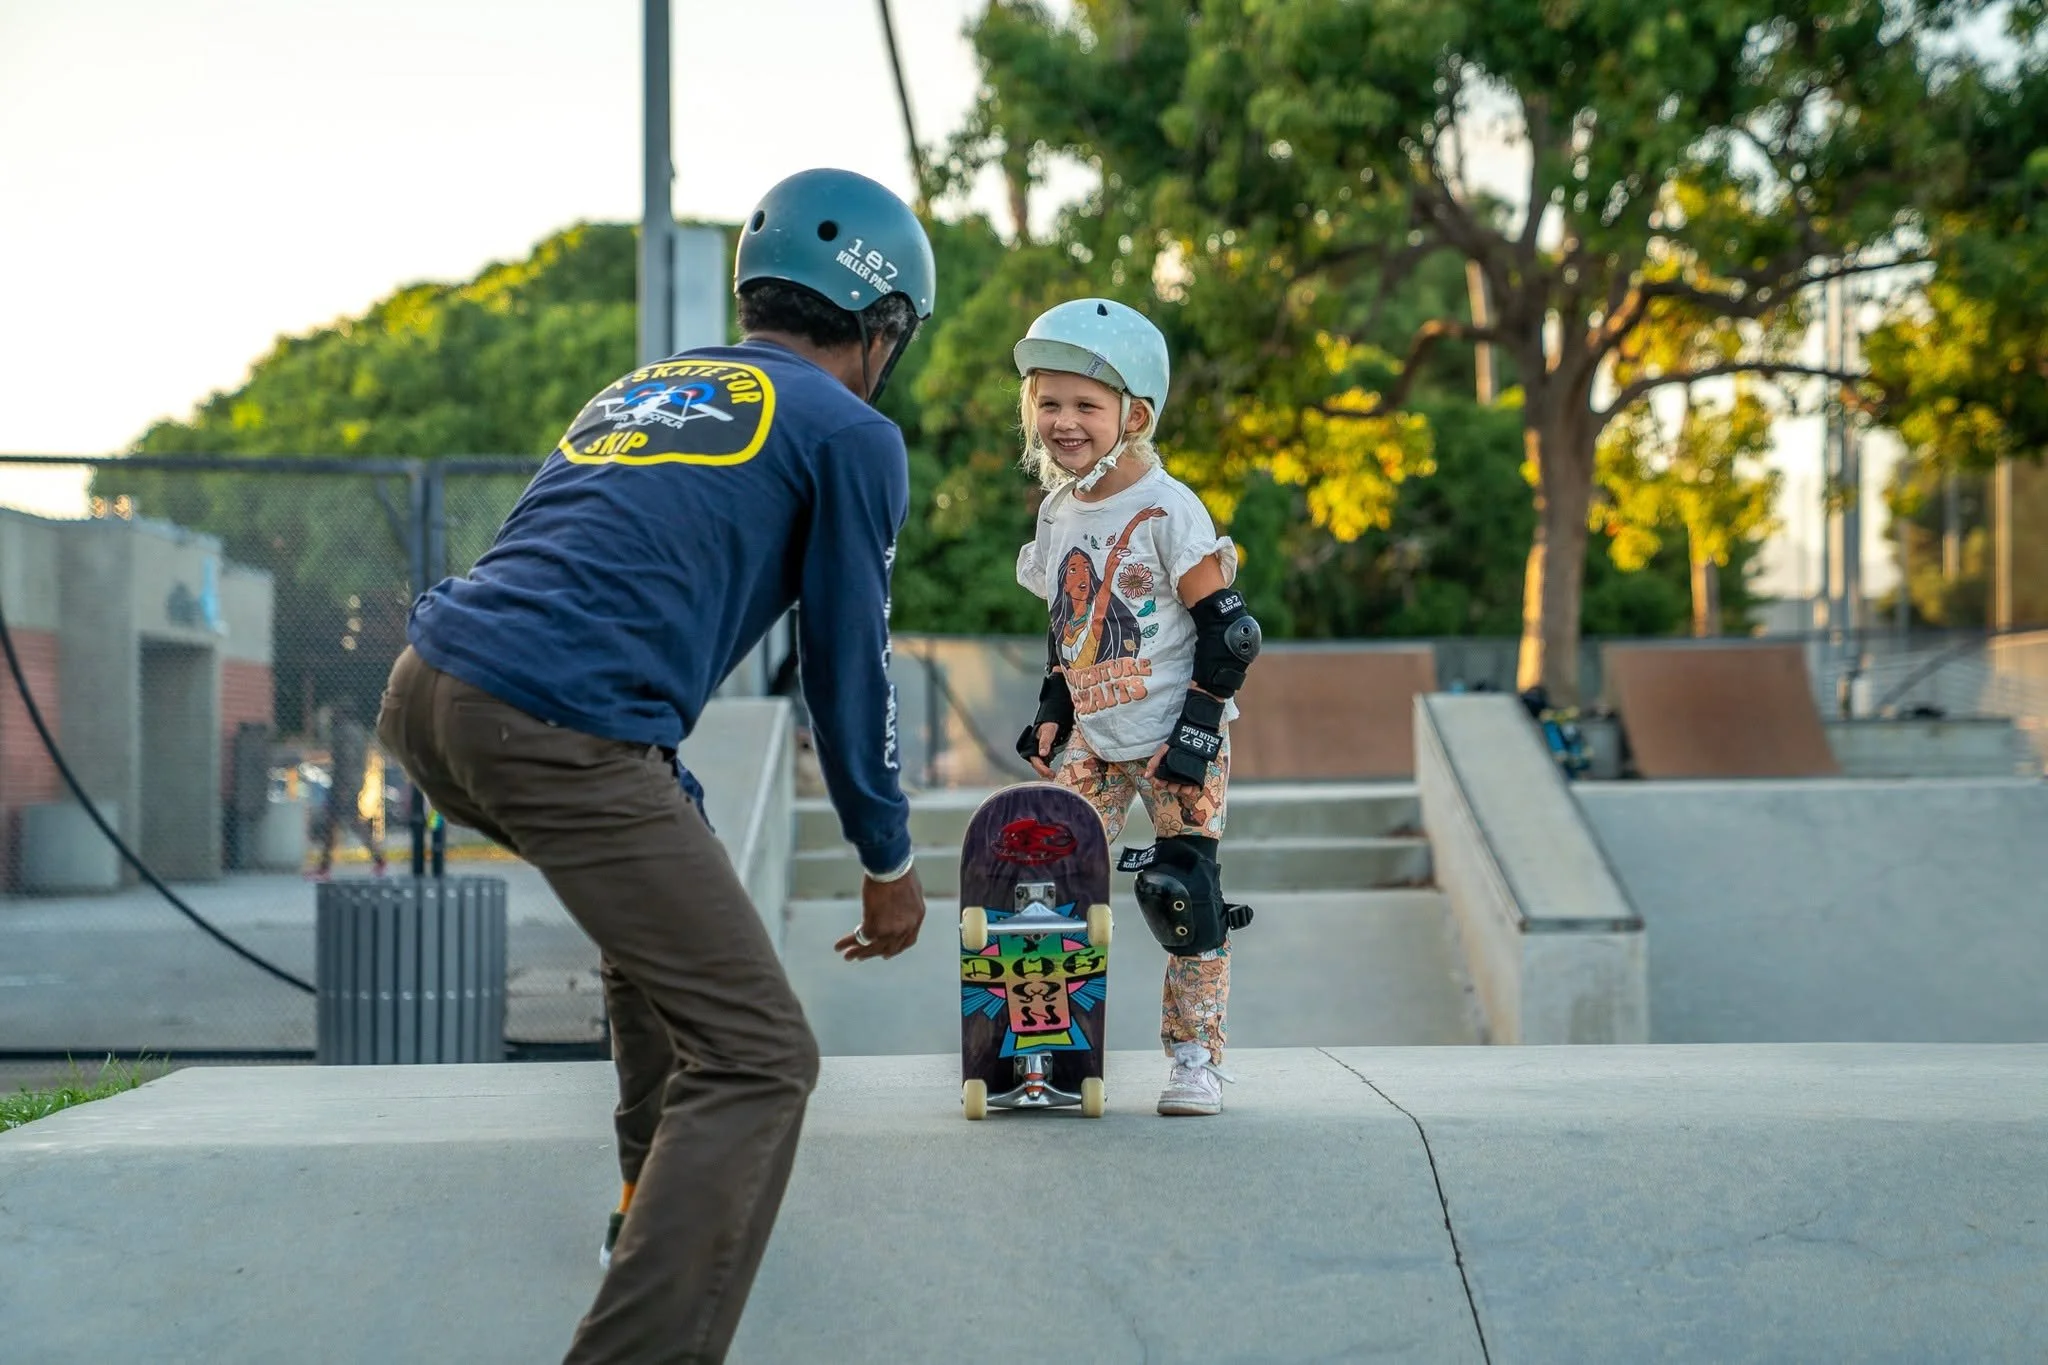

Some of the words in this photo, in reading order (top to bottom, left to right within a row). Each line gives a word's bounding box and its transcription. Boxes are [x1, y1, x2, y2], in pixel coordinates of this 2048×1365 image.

[848, 238, 898, 280] 187
[835, 250, 872, 280] KILLER
[868, 272, 893, 295] PADS
[631, 366, 729, 383] SKATE
[718, 371, 763, 405] FOR
[584, 431, 649, 455] SKIP
[1219, 594, 1238, 609] 187
[1179, 733, 1216, 753] 187
[1128, 847, 1156, 862] 187
